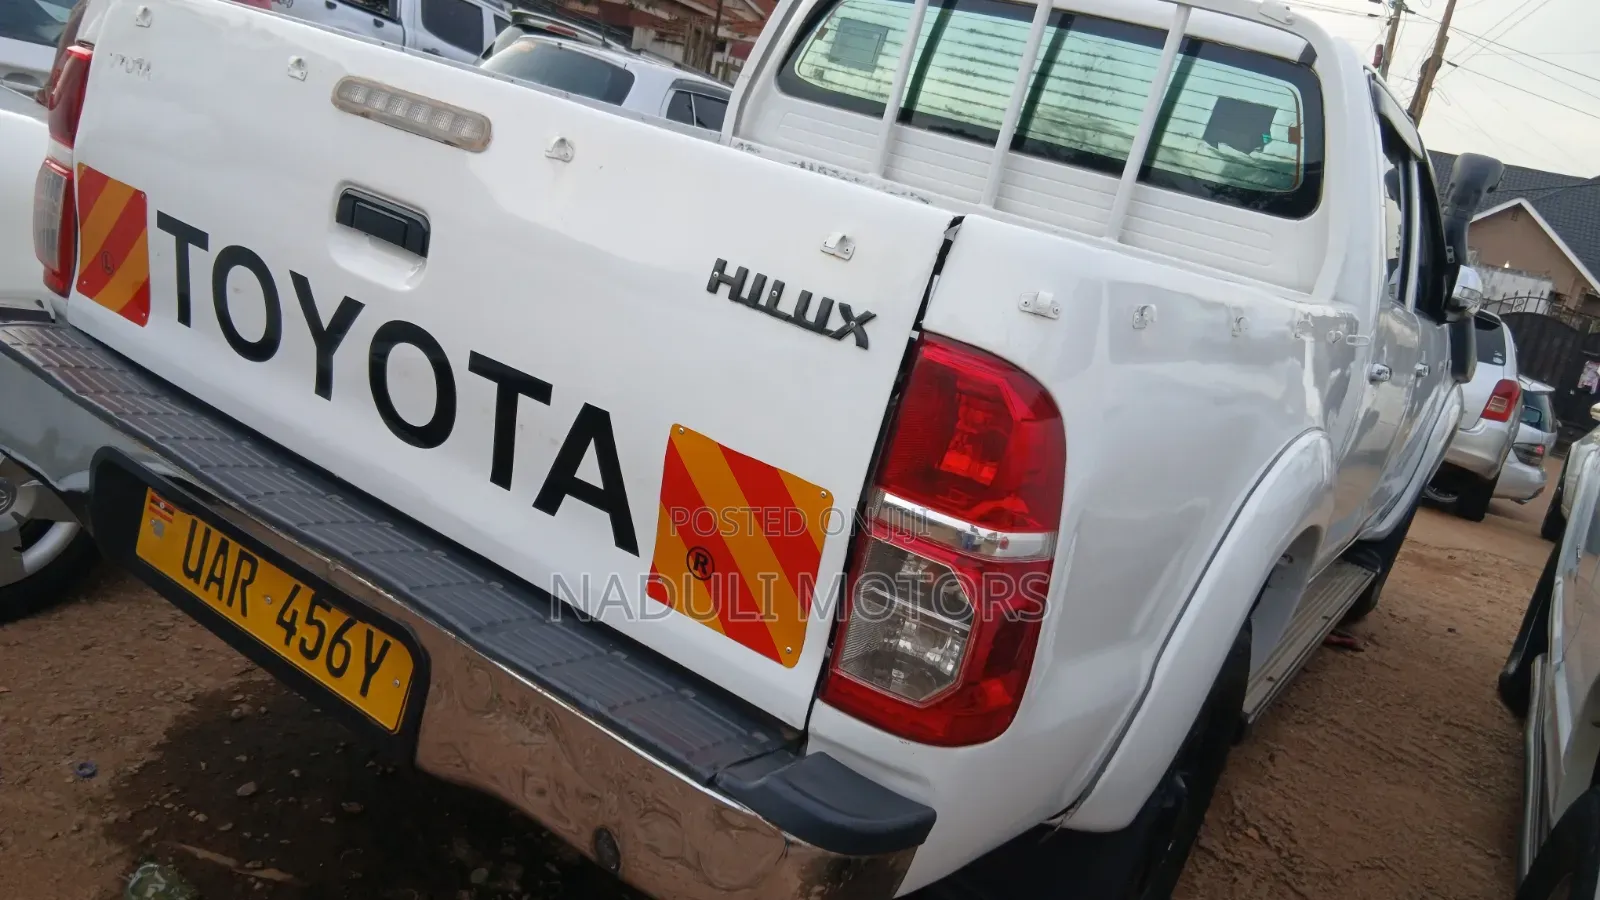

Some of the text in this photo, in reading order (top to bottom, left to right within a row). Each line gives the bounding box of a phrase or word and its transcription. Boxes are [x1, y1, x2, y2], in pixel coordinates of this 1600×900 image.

[157, 212, 638, 558] TOYOTA
[706, 257, 877, 351] HILUX
[182, 519, 391, 698] UAR 456Y
